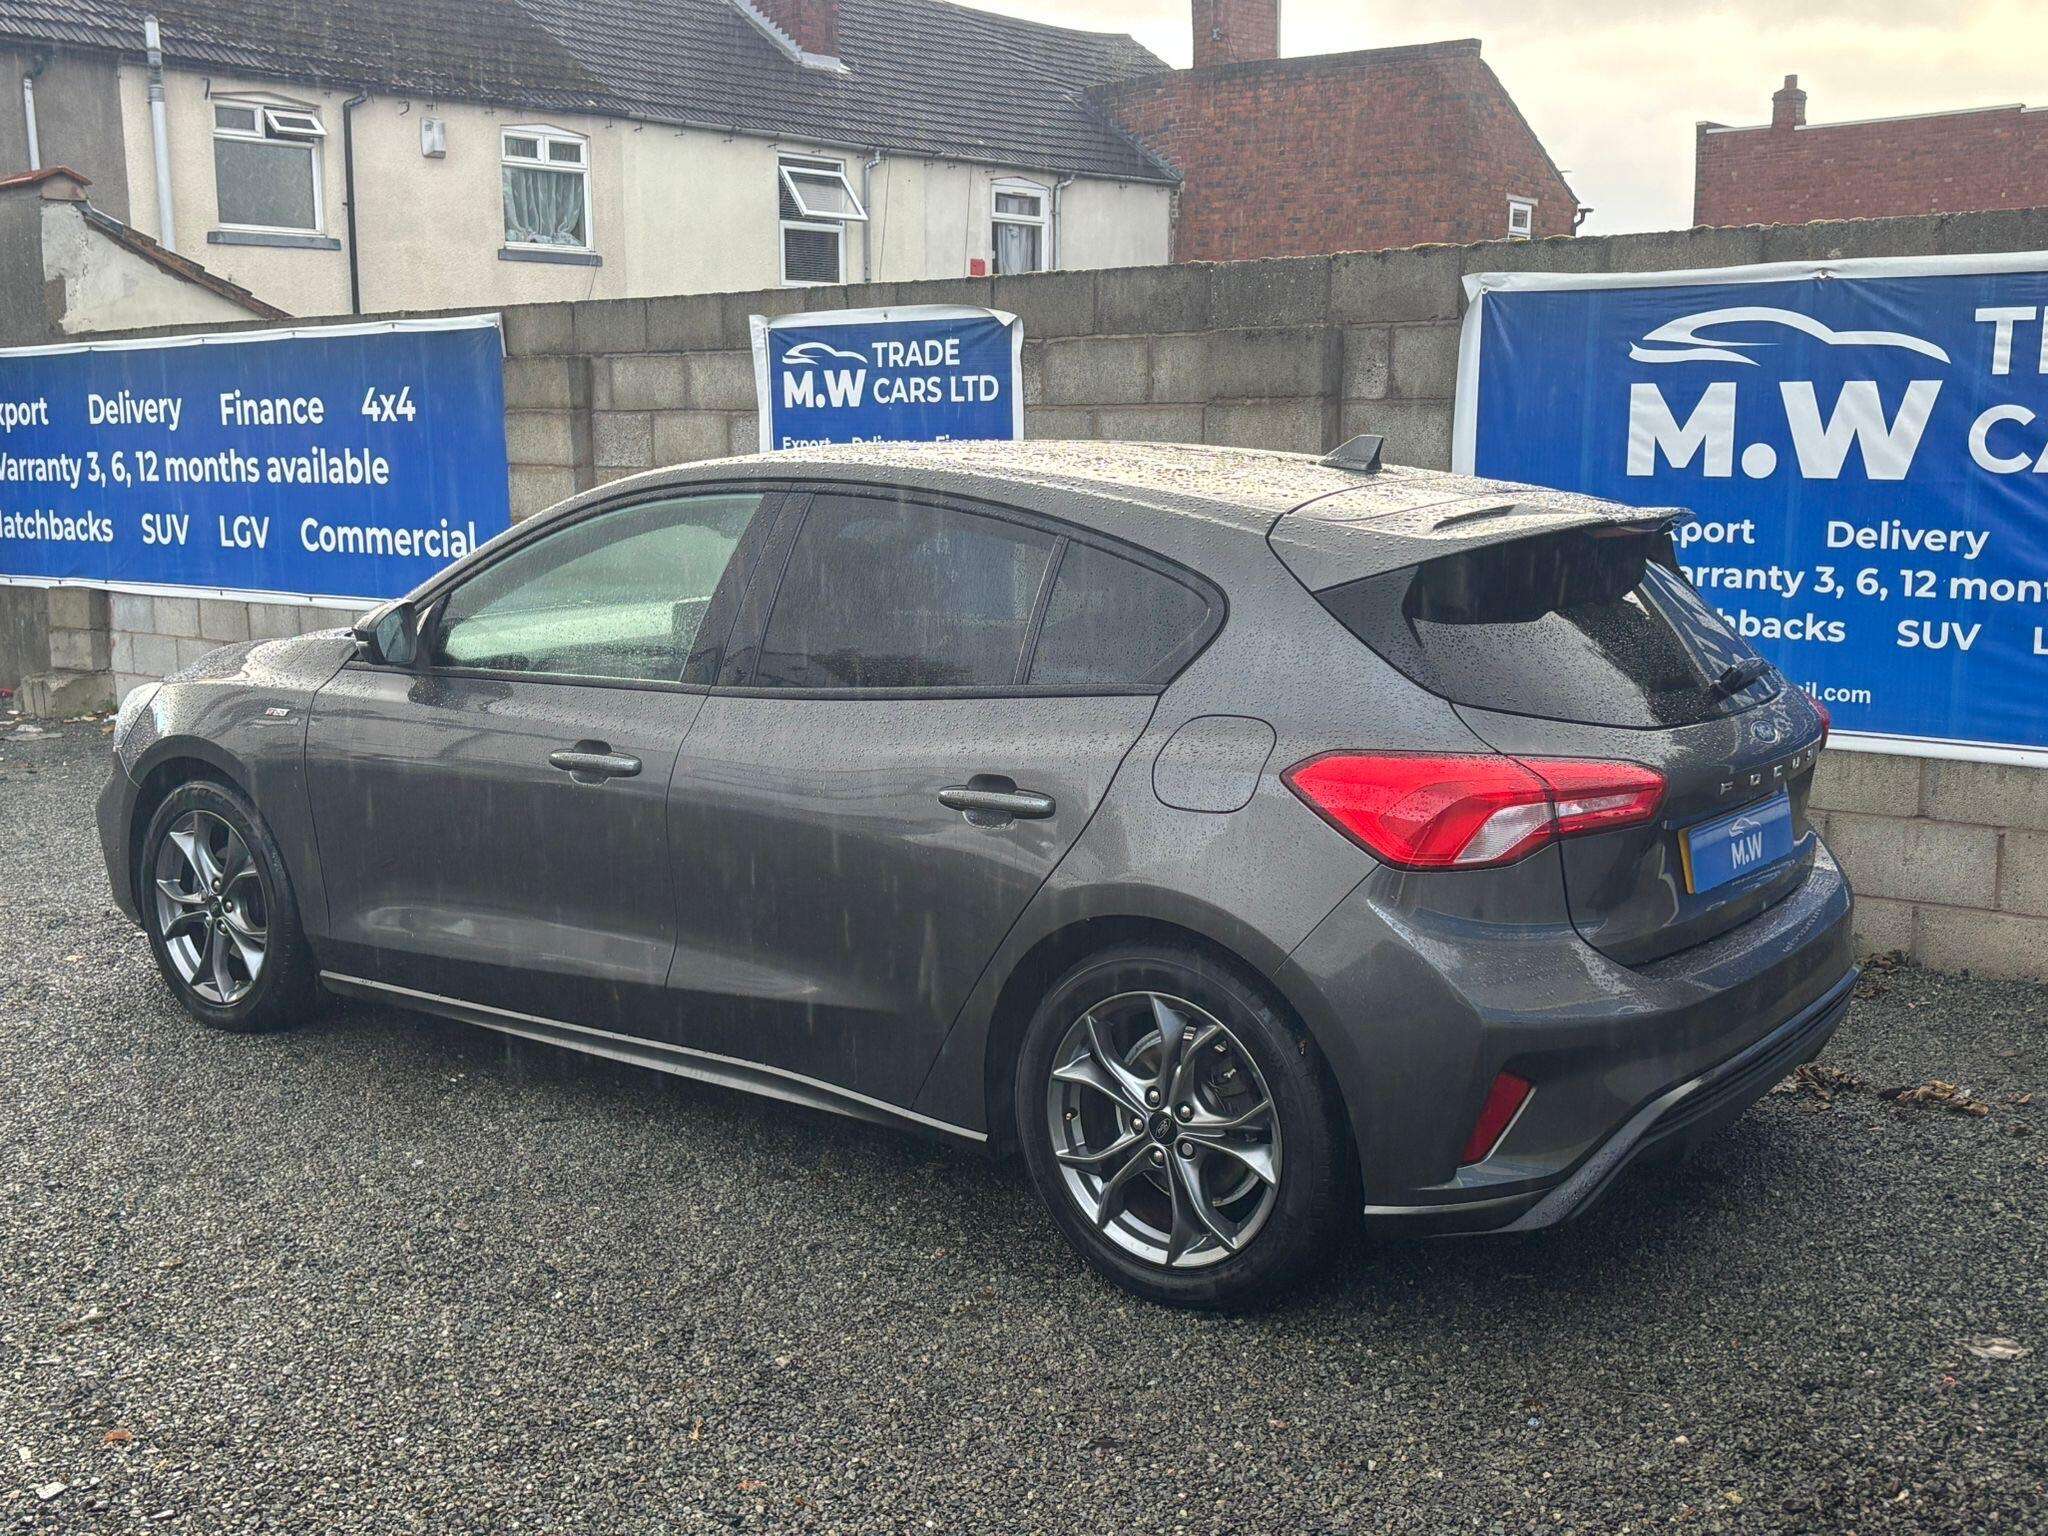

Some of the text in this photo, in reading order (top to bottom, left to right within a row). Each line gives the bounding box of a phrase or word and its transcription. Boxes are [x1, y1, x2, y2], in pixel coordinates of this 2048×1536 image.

[872, 339, 960, 367] TRADE
[1975, 306, 2048, 374] T
[88, 389, 182, 431] Delivery
[220, 389, 325, 426] Finance
[361, 386, 416, 422] 4x4
[783, 369, 866, 408] M.W
[873, 374, 999, 404] CARS LTD
[1627, 379, 1943, 480] M.W
[1968, 404, 2048, 473] C
[0, 447, 390, 489] arranty 3, 6, 12 months available
[0, 509, 476, 558] atchbacks SUV LGV Commercial
[1827, 520, 1990, 560] Delivery
[1813, 566, 1845, 599] 3,
[1856, 568, 1888, 601] 6,
[1900, 569, 1937, 598] 12
[1950, 577, 2048, 602] mon
[1897, 620, 1982, 651] SUV
[1730, 831, 1763, 869] M.W
